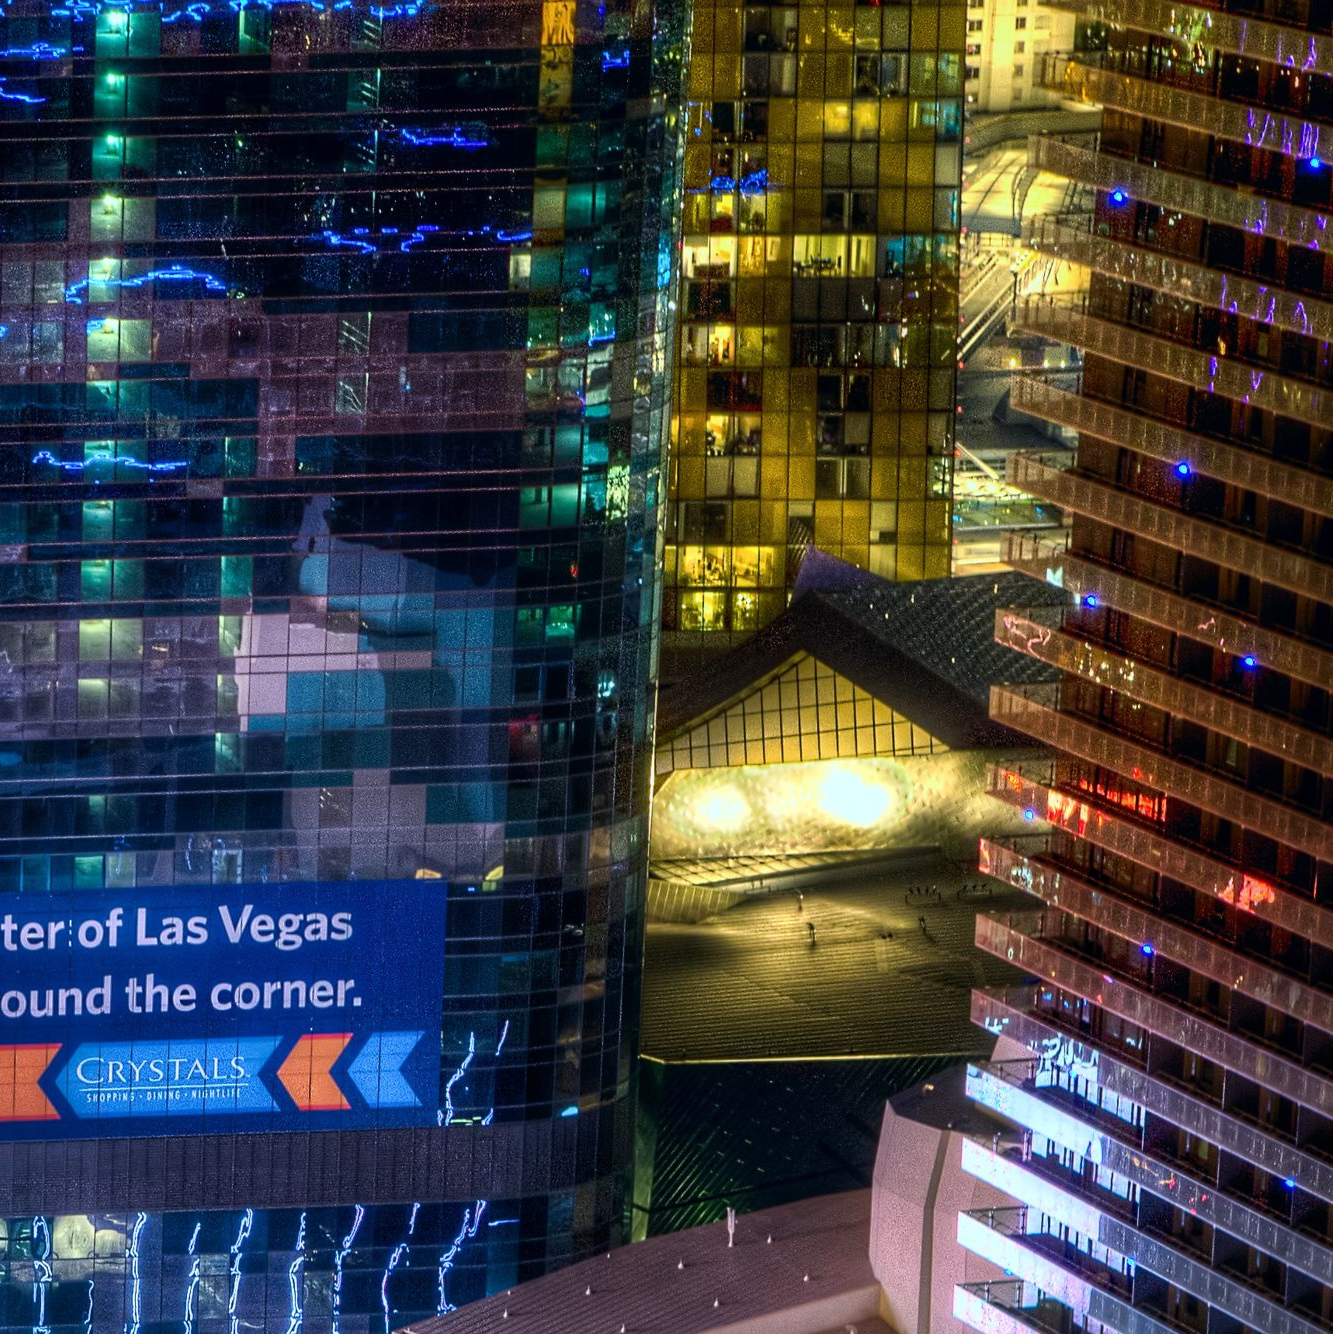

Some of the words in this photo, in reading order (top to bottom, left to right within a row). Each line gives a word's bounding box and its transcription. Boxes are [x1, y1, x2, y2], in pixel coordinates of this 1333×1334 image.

[78, 907, 123, 948] of
[136, 907, 209, 948] Las
[218, 904, 354, 951] Vegas
[125, 973, 196, 1013] the
[210, 979, 362, 1012] corner.
[76, 1056, 246, 1085] CRYSTALS
[86, 1091, 135, 1103] SHOPPING
[146, 1090, 181, 1101] DINING
[191, 1088, 241, 1100] NIGHTLIFE
